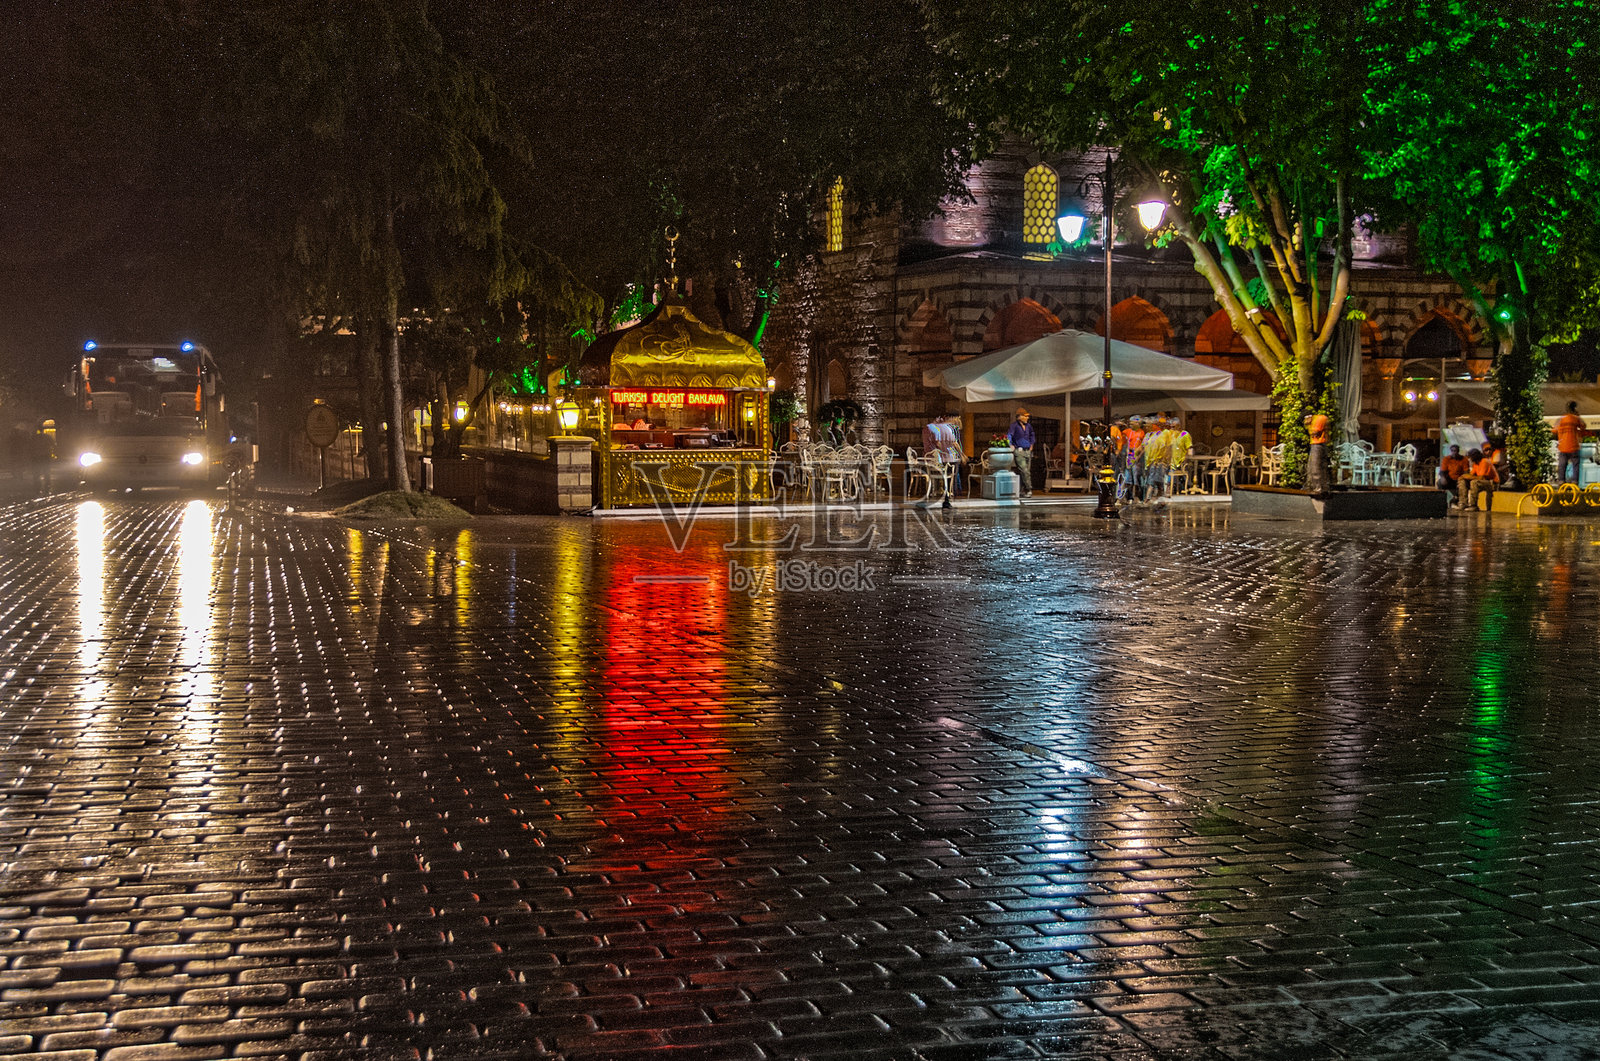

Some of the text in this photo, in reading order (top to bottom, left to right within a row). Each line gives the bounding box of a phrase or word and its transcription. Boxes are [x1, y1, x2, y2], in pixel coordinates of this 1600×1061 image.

[612, 392, 725, 404] TURKISH DELIGHT BAKLAVA
